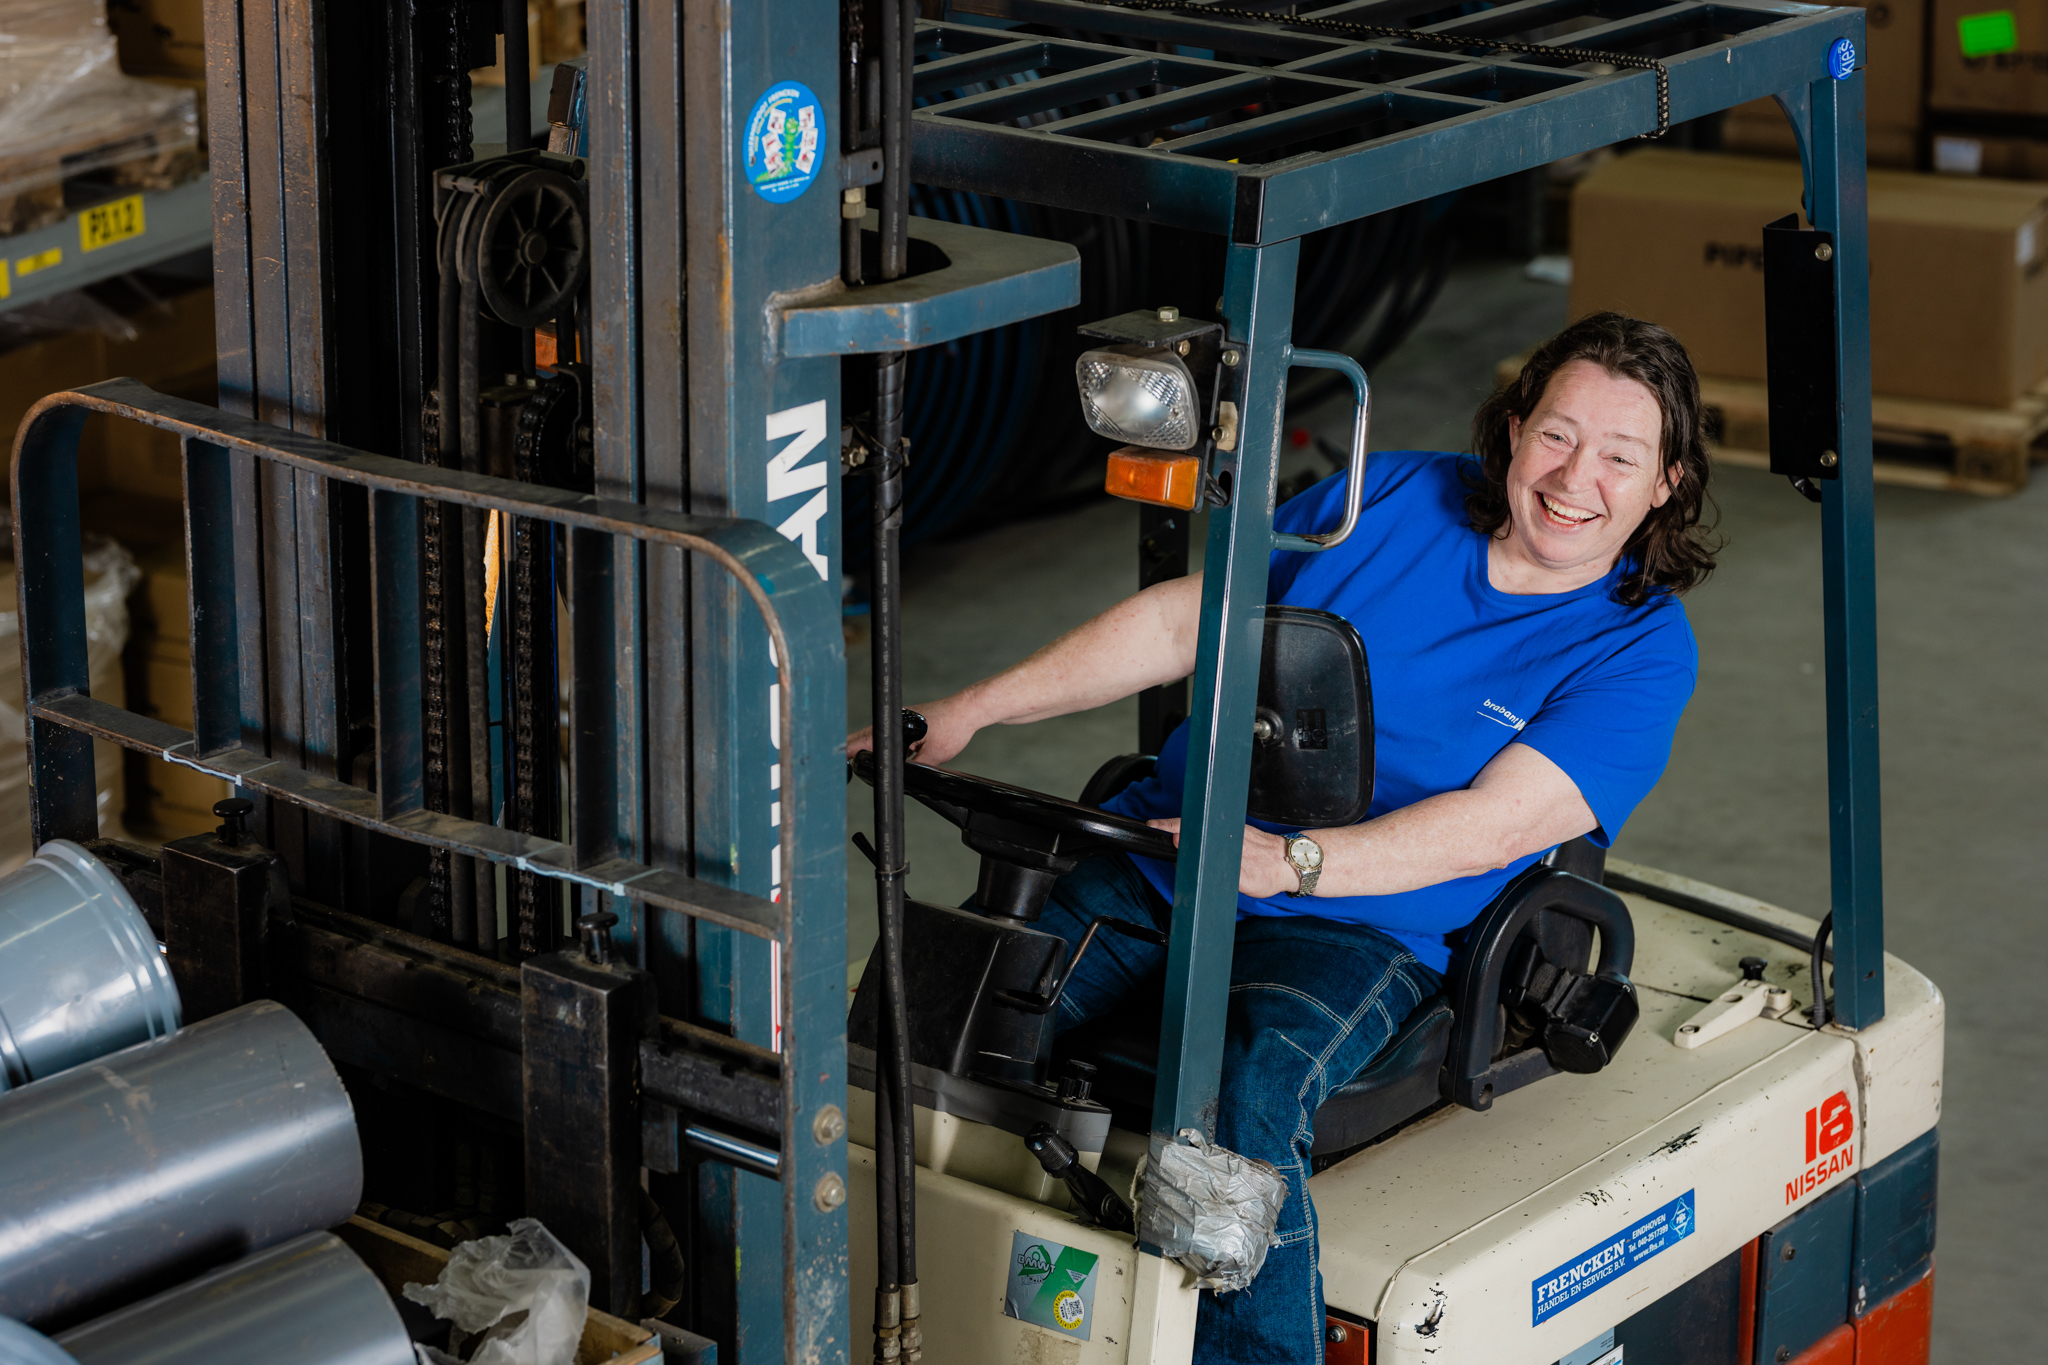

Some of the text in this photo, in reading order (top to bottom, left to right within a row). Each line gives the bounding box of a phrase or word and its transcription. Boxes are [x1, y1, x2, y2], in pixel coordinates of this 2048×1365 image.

[1805, 1090, 1854, 1165] 18
[1786, 1143, 1854, 1207] NISSAN
[1632, 1213, 1667, 1240] EINDHOVEN
[1017, 1253, 1056, 1274] BMWT
[1628, 1243, 1638, 1254] Tel.
[1633, 1237, 1665, 1262] www.fhs.nl
[1537, 1238, 1626, 1304] FRENCKEN
[1537, 1257, 1626, 1316] HANDEL EN SERVICE B.V.
